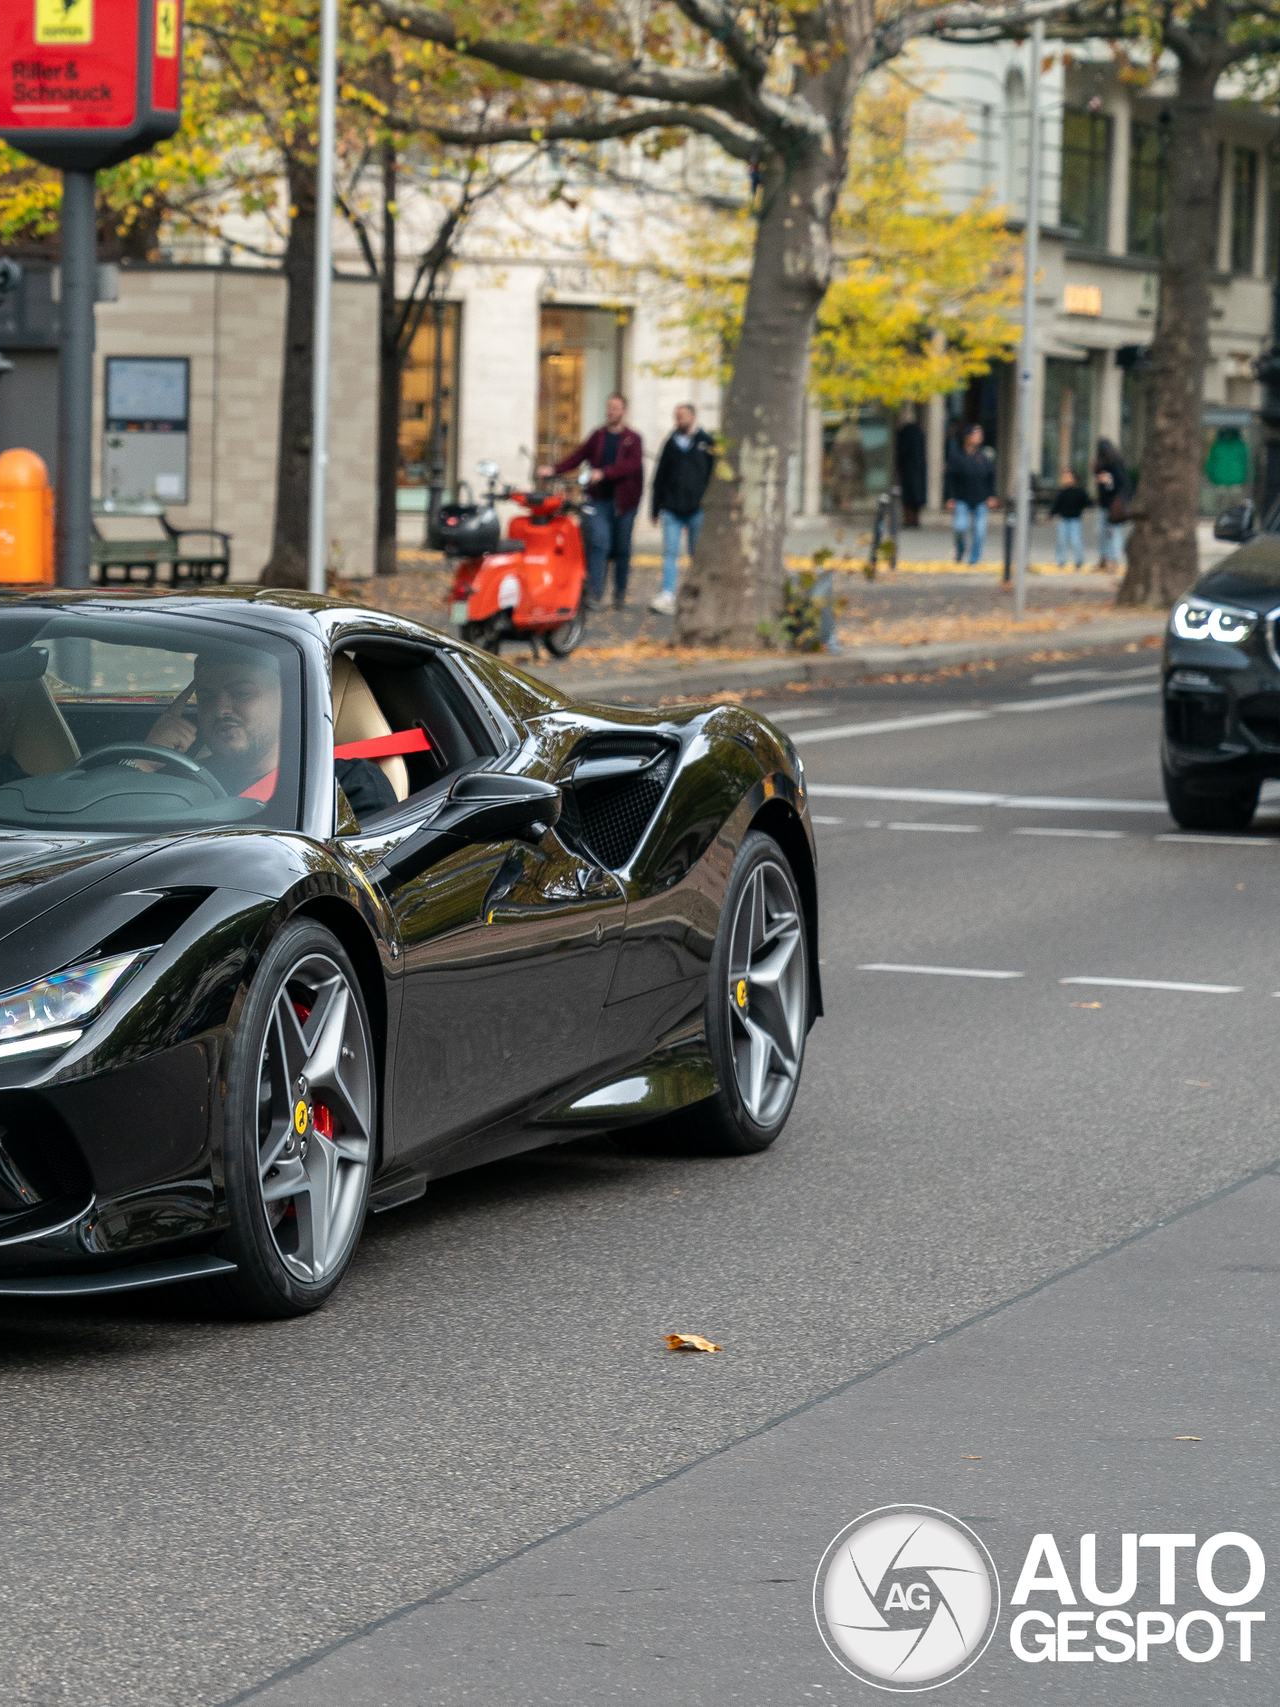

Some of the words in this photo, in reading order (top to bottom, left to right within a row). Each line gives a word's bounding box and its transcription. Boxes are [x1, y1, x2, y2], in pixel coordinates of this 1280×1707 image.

[12, 60, 61, 80] Riller
[64, 60, 79, 80] &
[13, 82, 111, 102] Schnauck
